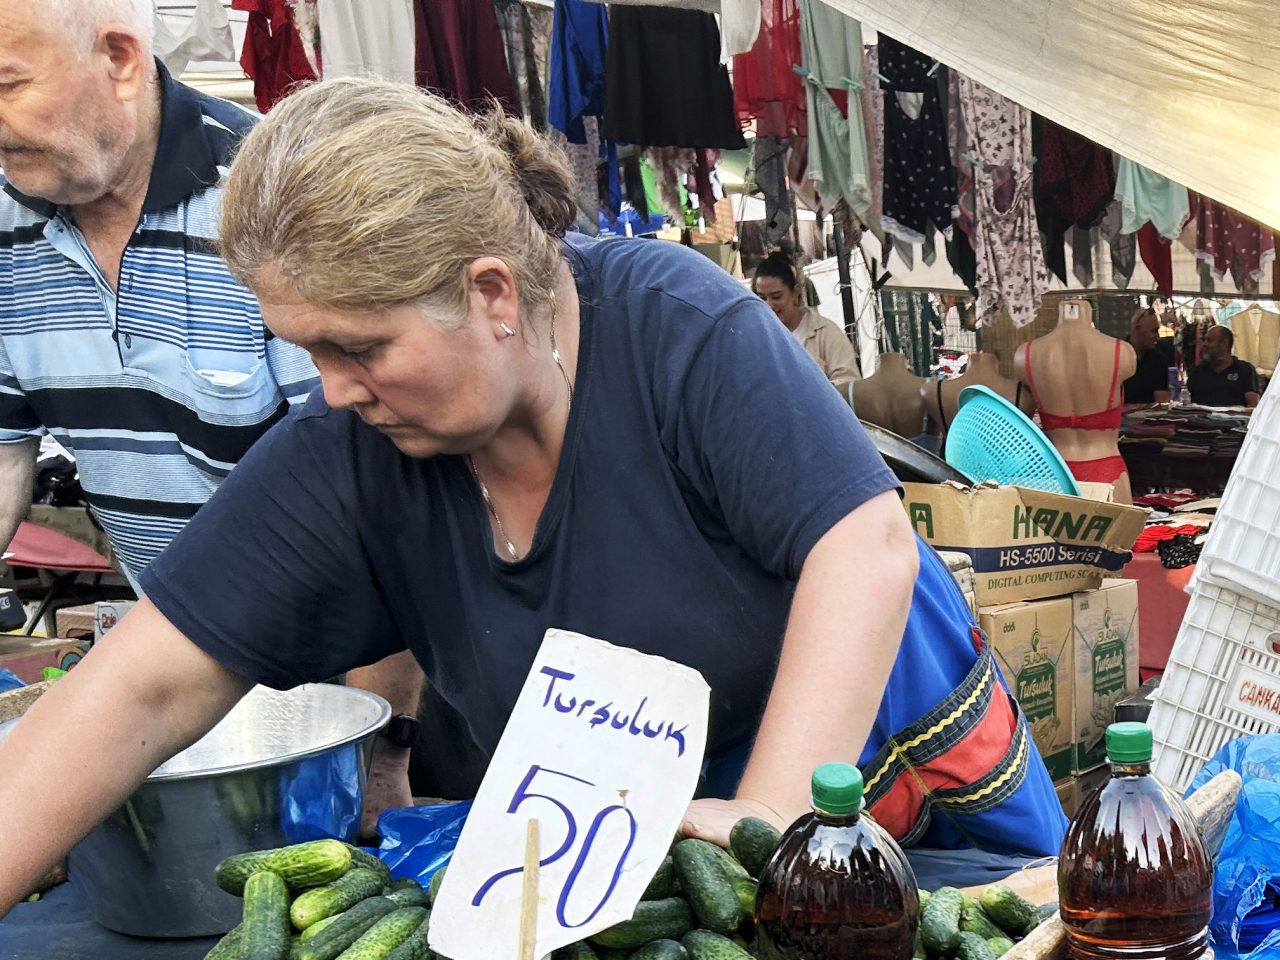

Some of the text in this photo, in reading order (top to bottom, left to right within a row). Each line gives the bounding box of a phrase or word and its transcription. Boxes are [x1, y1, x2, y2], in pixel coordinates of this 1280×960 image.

[1012, 504, 1112, 541] HANA
[1000, 545, 1102, 568] HS-5500 Serisi
[987, 575, 1024, 590] DIGITAL
[1024, 569, 1076, 585] COMPUTING
[471, 763, 640, 929] 50
